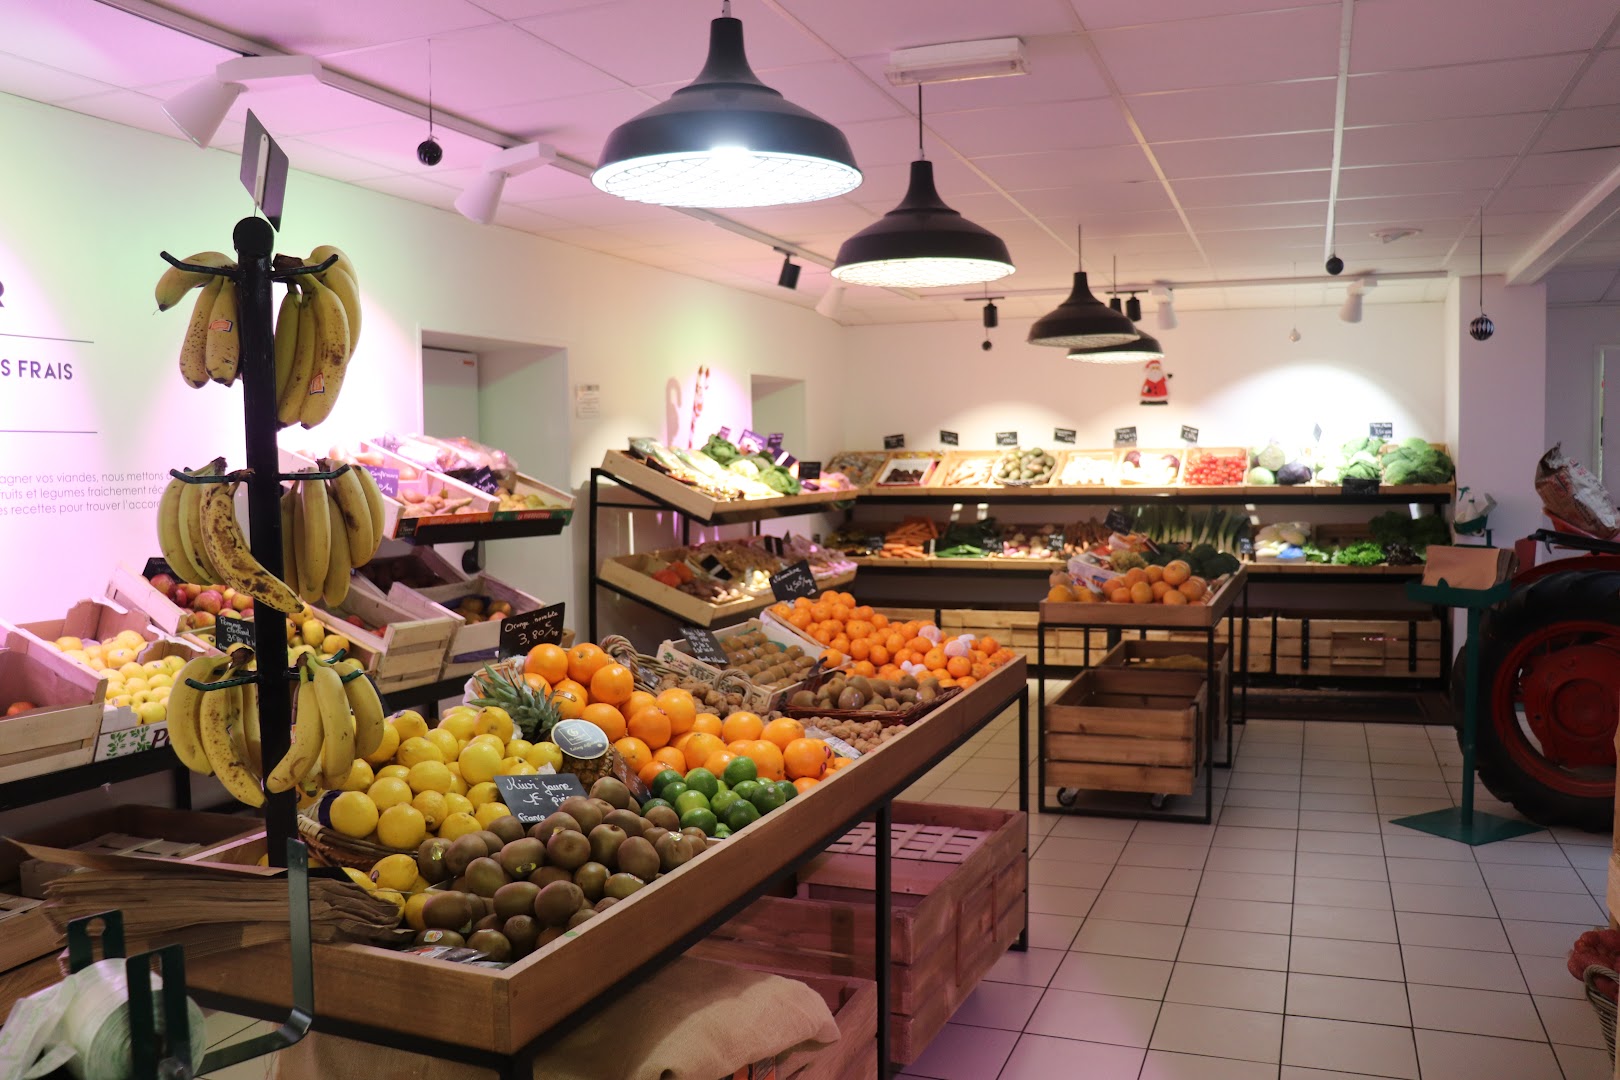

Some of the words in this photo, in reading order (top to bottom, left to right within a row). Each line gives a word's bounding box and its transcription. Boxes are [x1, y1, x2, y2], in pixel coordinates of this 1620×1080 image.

[18, 360, 73, 380] FRAIS
[35, 475, 54, 483] vos
[56, 472, 98, 483] viandes,
[101, 473, 124, 482] nous
[126, 471, 163, 481] mettons
[0, 488, 23, 499] ruits
[26, 489, 37, 499] et
[11, 504, 57, 515] recettes
[59, 504, 83, 515] pour
[86, 502, 120, 511] trouver
[504, 621, 530, 633] Orange
[506, 776, 540, 791] Kiwi
